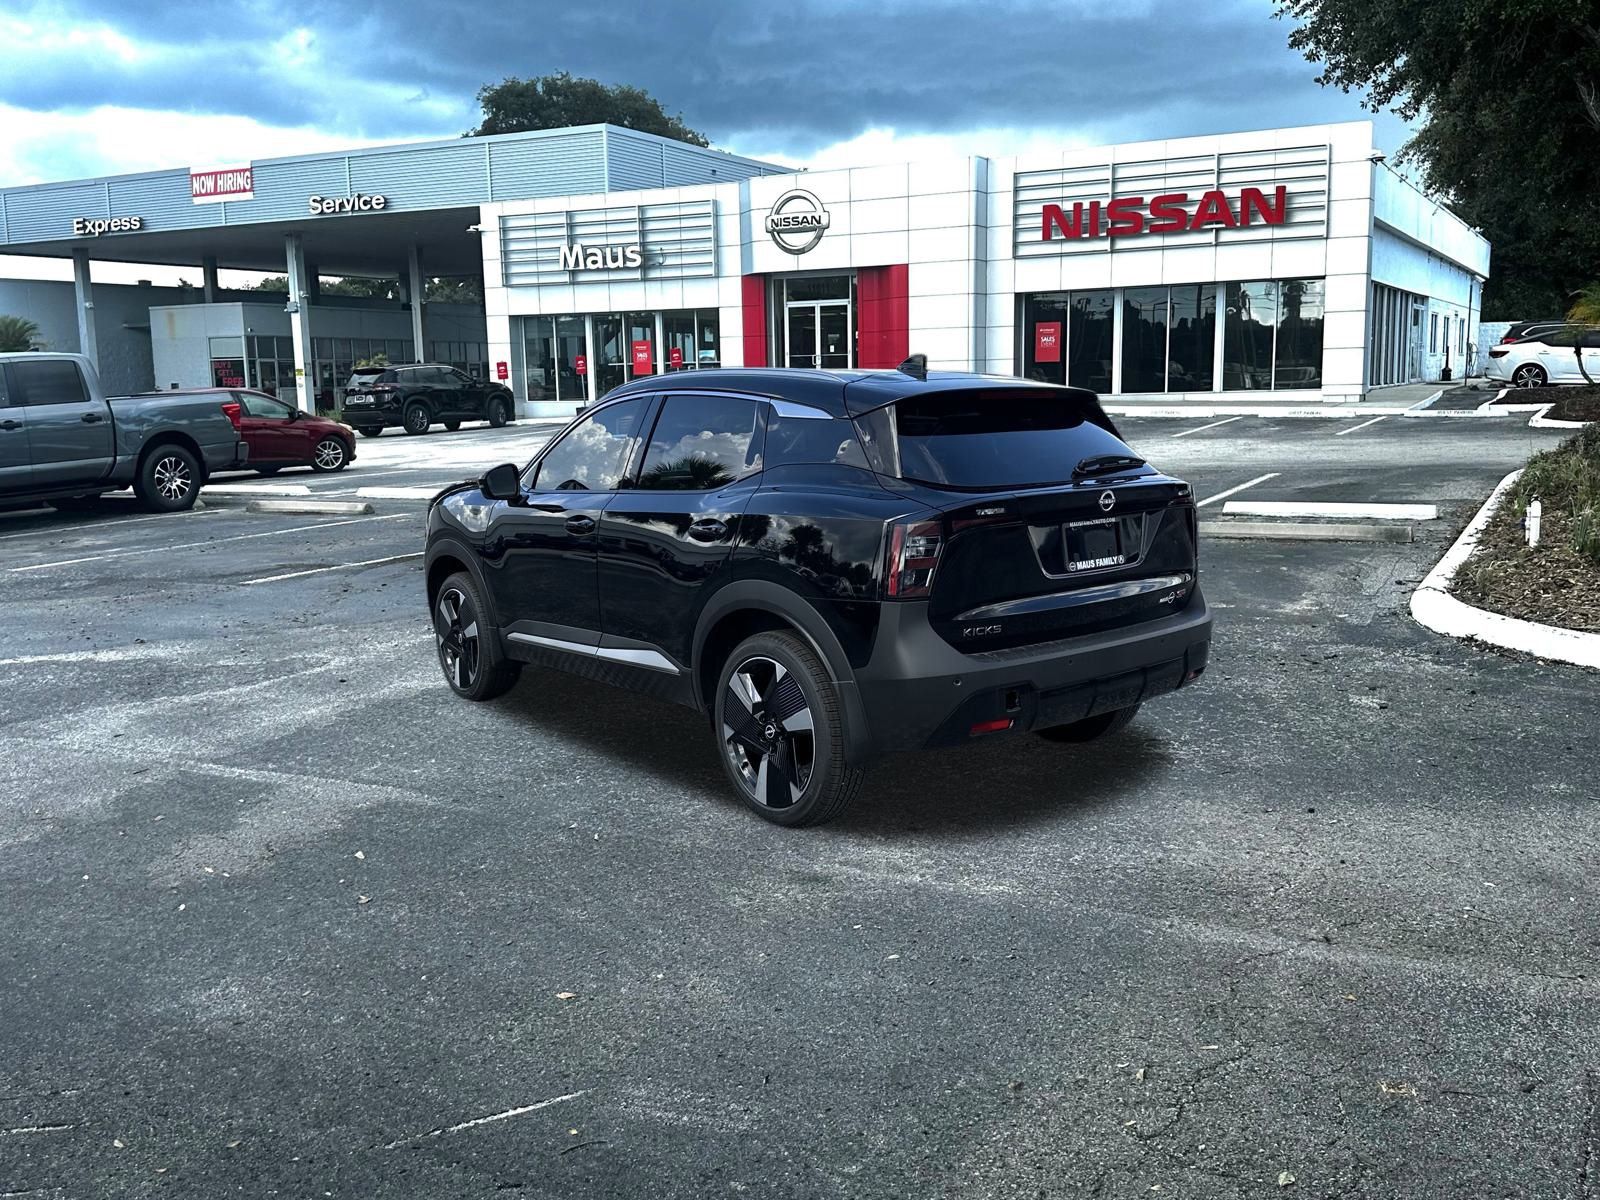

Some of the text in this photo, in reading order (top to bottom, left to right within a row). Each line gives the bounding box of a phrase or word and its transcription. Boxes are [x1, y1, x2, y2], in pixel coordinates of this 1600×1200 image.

[192, 171, 251, 195] NOW HIRING
[309, 193, 385, 215] Service
[1042, 185, 1287, 241] NISSAN
[73, 216, 141, 237] Express
[770, 214, 822, 228] NISSAN
[560, 243, 642, 270] Maus
[223, 377, 244, 387] FREE
[1076, 555, 1118, 570] MAUS FAMILY
[963, 624, 1002, 637] KICKS
